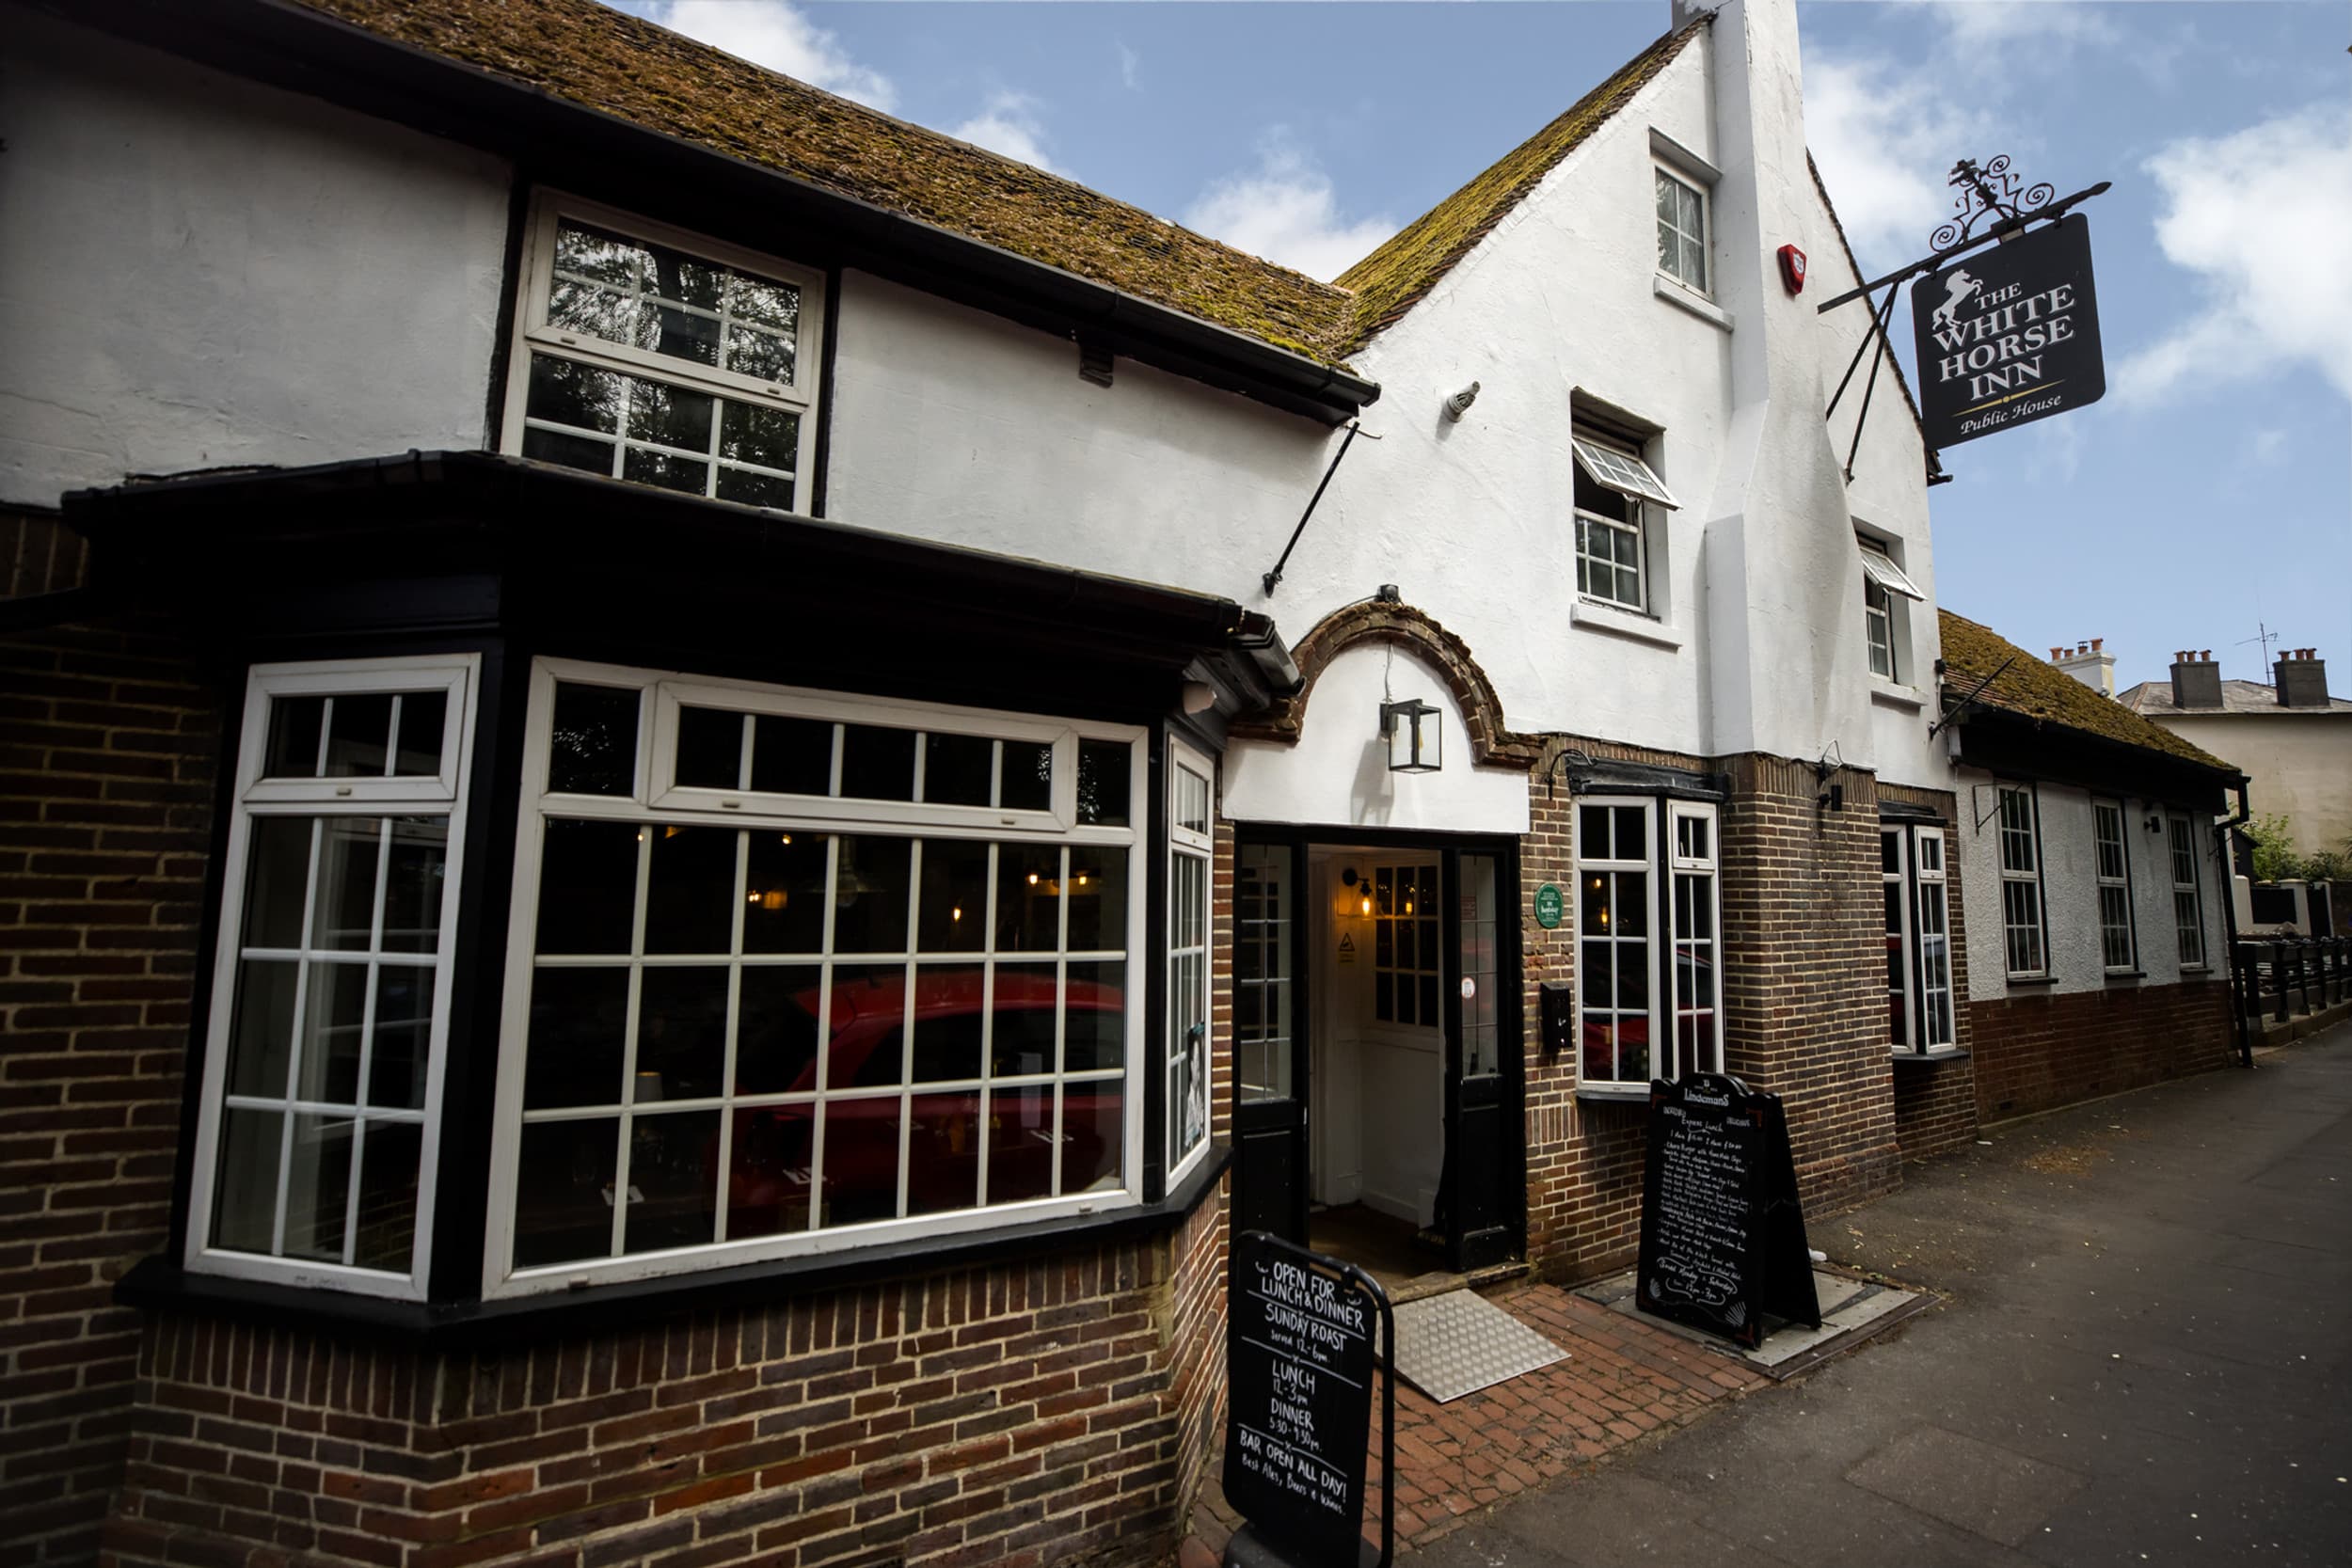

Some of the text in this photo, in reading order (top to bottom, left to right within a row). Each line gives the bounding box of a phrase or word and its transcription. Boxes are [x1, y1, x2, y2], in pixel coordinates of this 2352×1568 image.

[1932, 284, 2075, 352] WHITE
[1974, 282, 2022, 310] THE
[1938, 315, 2074, 382] HORSE
[1970, 354, 2043, 401] INN
[1961, 394, 2061, 436] Public House
[1273, 1261, 1335, 1301] OPEN FOR
[1262, 1276, 1303, 1307] LUNCH
[1314, 1295, 1365, 1334] DINNER
[1264, 1303, 1347, 1352] SUNDAY ROAST
[1272, 1359, 1315, 1395] LUNCH
[1271, 1398, 1314, 1432] DINNER
[1240, 1430, 1347, 1504] BAR OPEN ALL DAY!
[1242, 1453, 1259, 1471] Best
